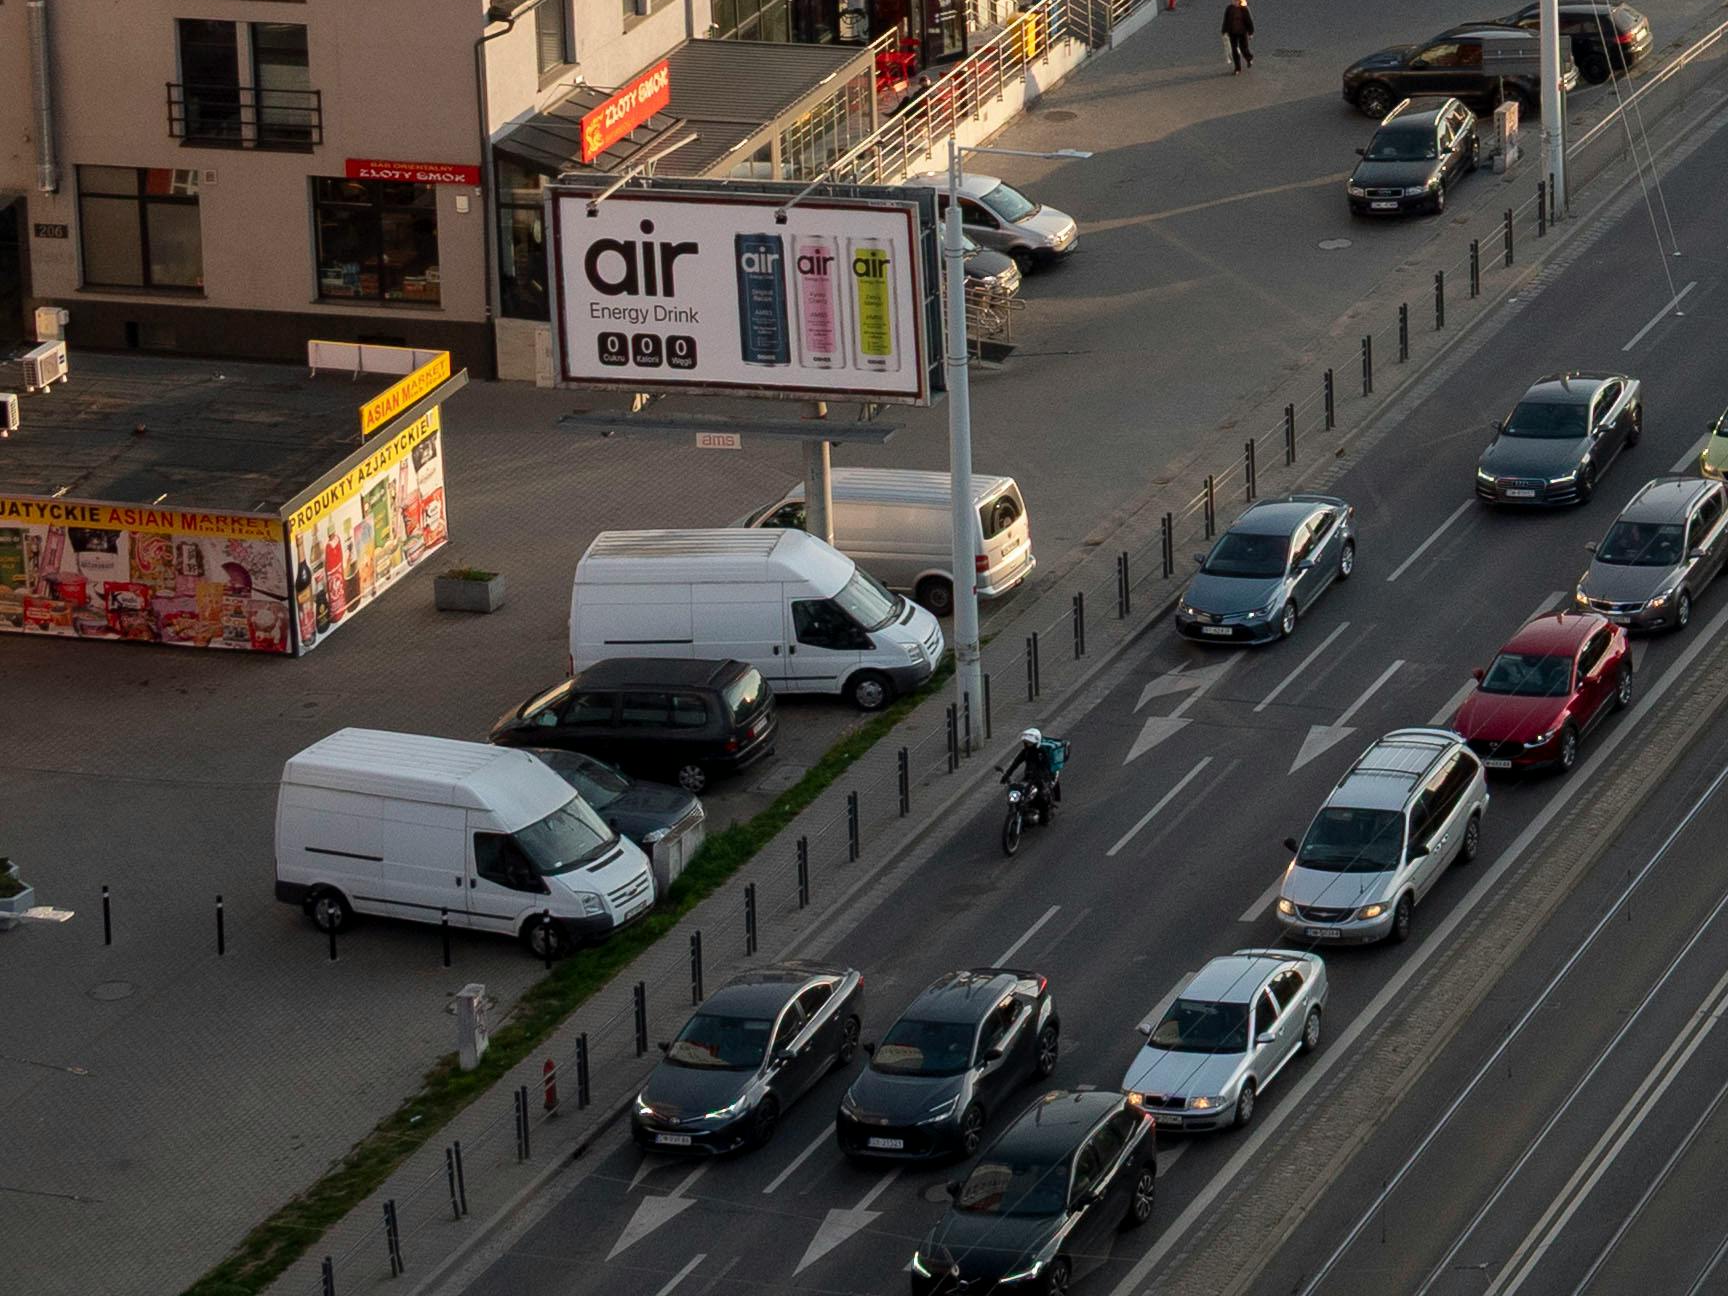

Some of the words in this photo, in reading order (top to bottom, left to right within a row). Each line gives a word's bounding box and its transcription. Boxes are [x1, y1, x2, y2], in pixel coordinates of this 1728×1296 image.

[604, 88, 637, 128] ZŁOTY
[637, 67, 669, 103] SMOK
[359, 168, 411, 180] ZŁOTY
[415, 171, 466, 183] SMOK
[370, 160, 390, 170] BAR
[392, 161, 454, 172] ORIENTALNY
[584, 219, 699, 298] air
[741, 246, 779, 274] air
[797, 248, 835, 276] air
[853, 251, 891, 278] air
[590, 302, 649, 324] Energy
[654, 305, 700, 324] Drink
[607, 336, 619, 352] 0
[641, 337, 653, 354] 0
[675, 339, 687, 356] 0
[603, 353, 626, 362] Cukru
[366, 393, 400, 429] ASIAN
[401, 359, 447, 404] MARKET
[702, 434, 735, 446] ams
[290, 475, 354, 533] PRODUKTY
[358, 419, 428, 486] AZJATYCKIE
[108, 508, 174, 528] ASIAN
[181, 513, 273, 532] MARKET
